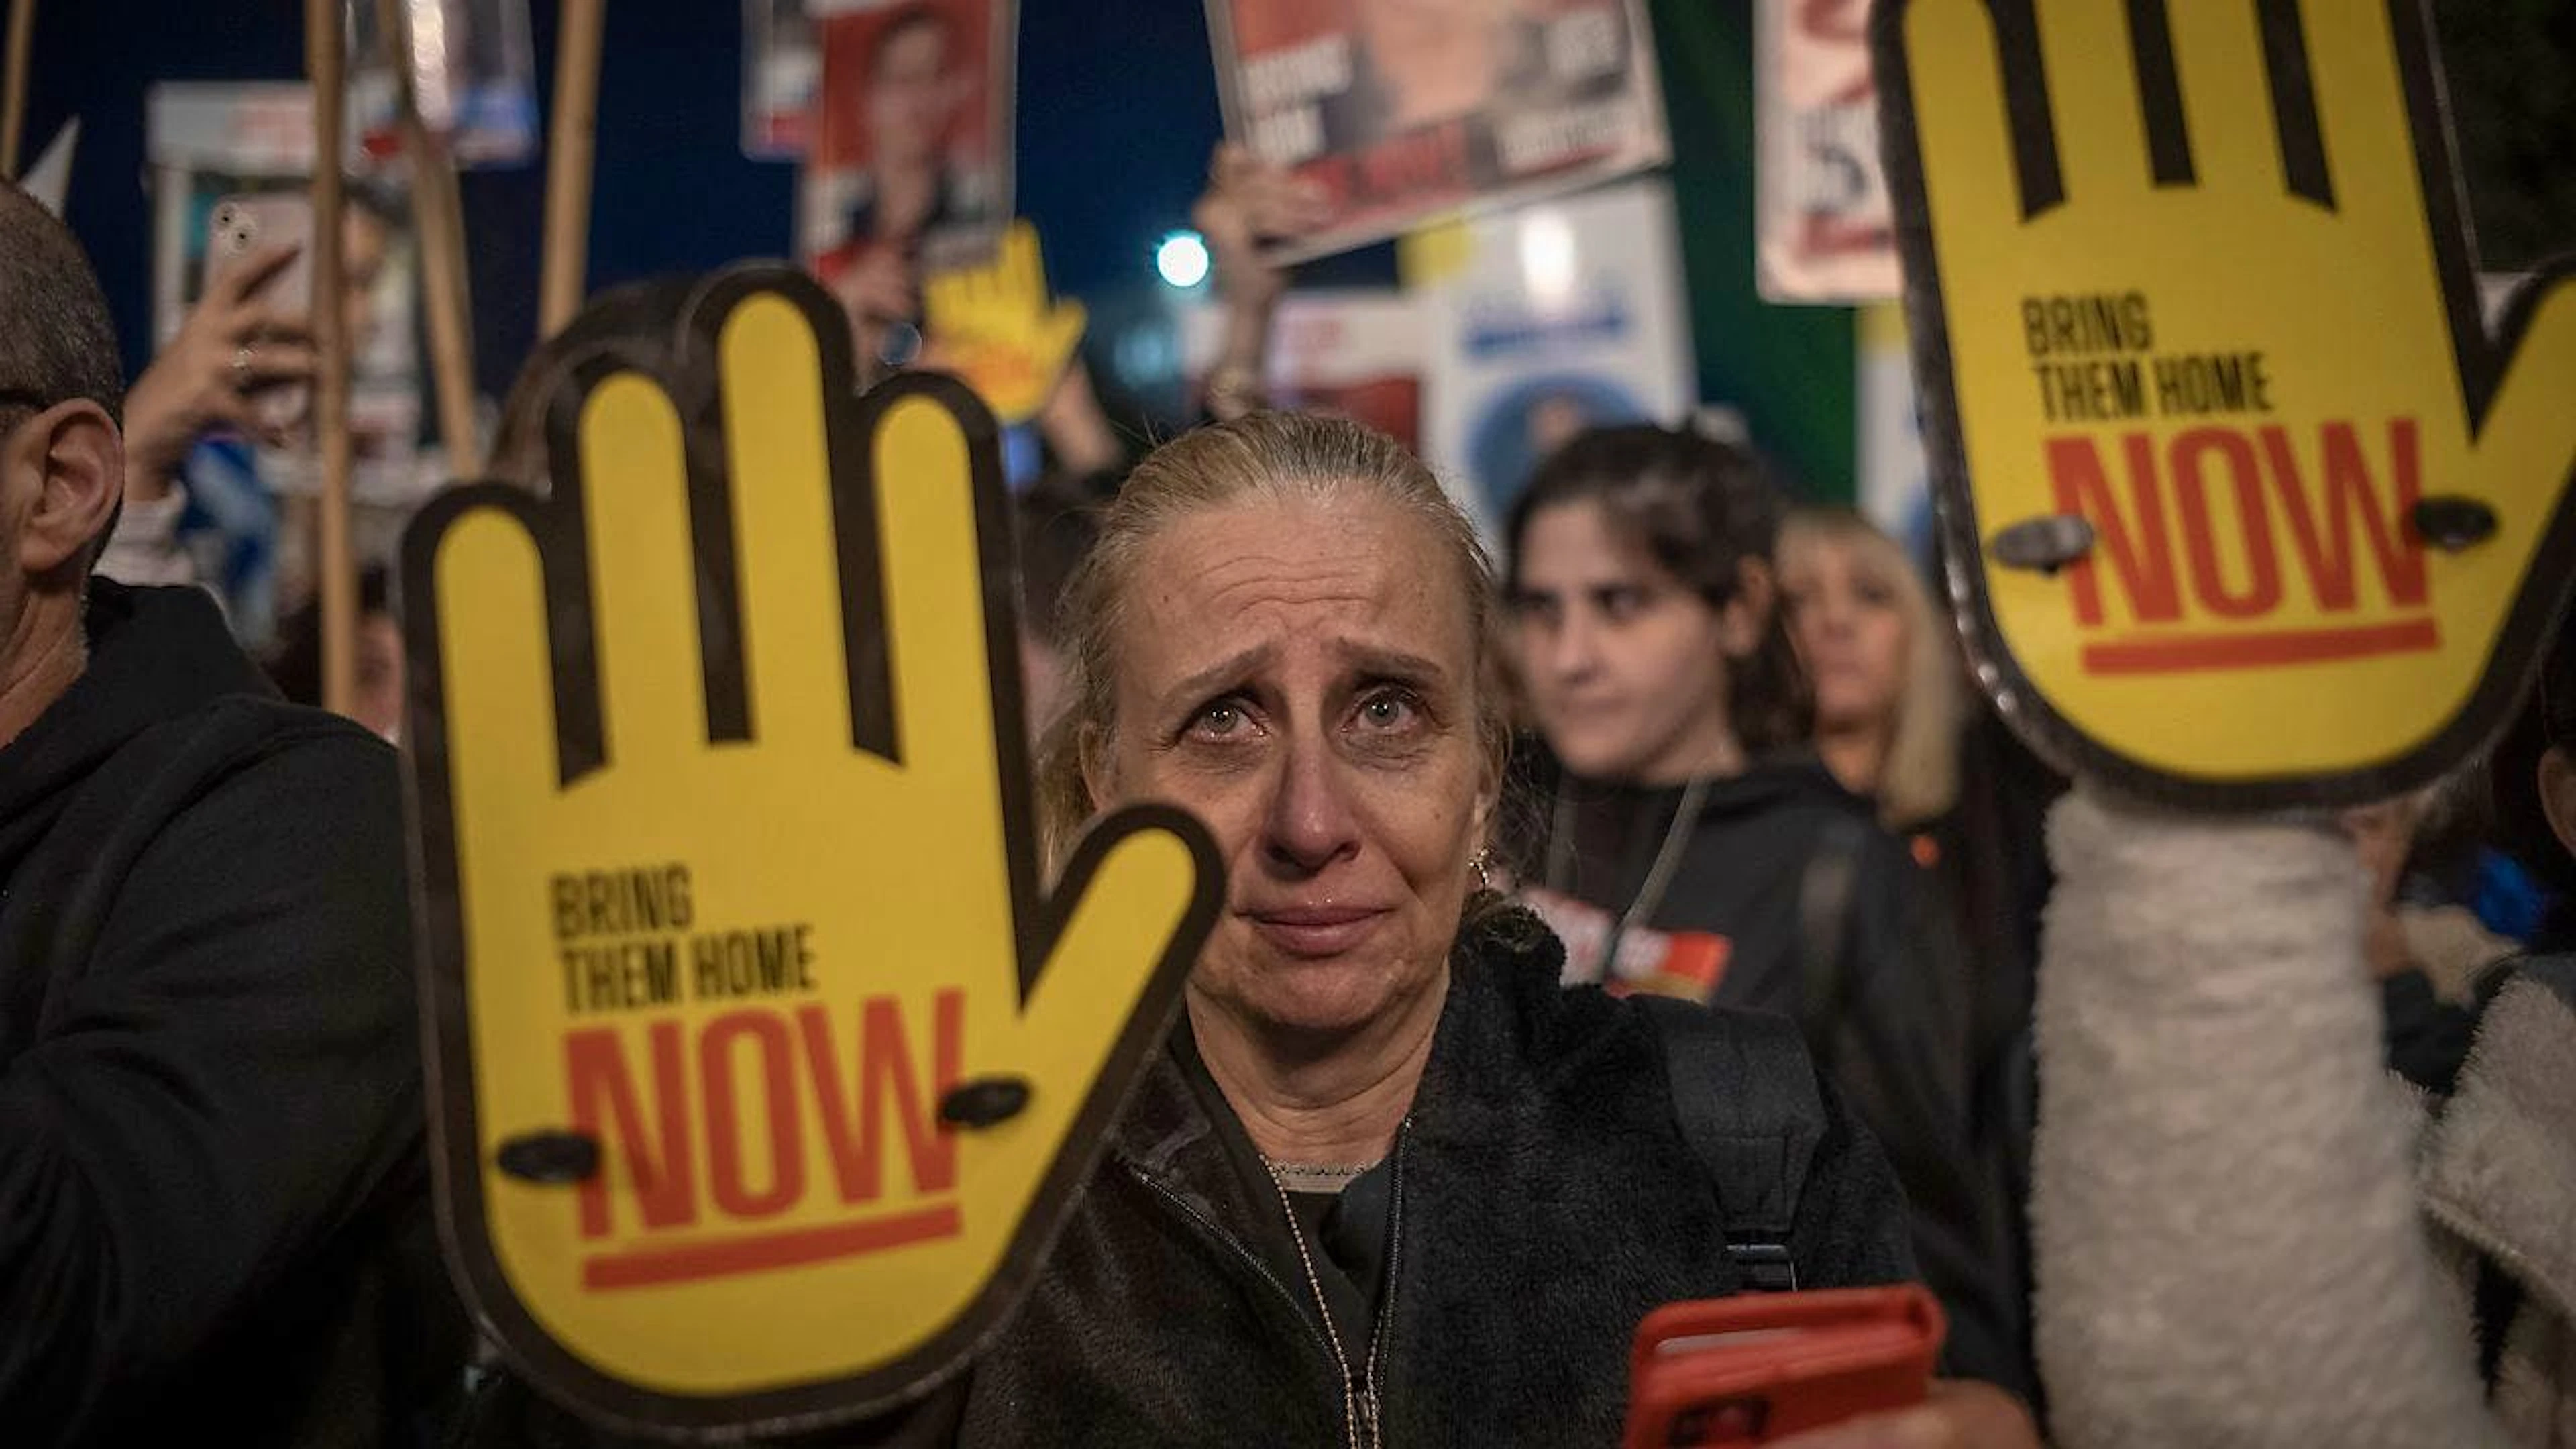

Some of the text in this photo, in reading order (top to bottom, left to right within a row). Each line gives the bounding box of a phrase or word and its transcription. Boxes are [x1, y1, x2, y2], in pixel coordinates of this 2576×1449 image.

[2022, 294, 2151, 356] BRING
[2033, 352, 2272, 421] THEM HOME
[2047, 418, 2428, 625] NOW
[553, 865, 692, 938] BRING
[562, 924, 817, 1012] THEM HOME
[565, 988, 965, 1238] NOW
